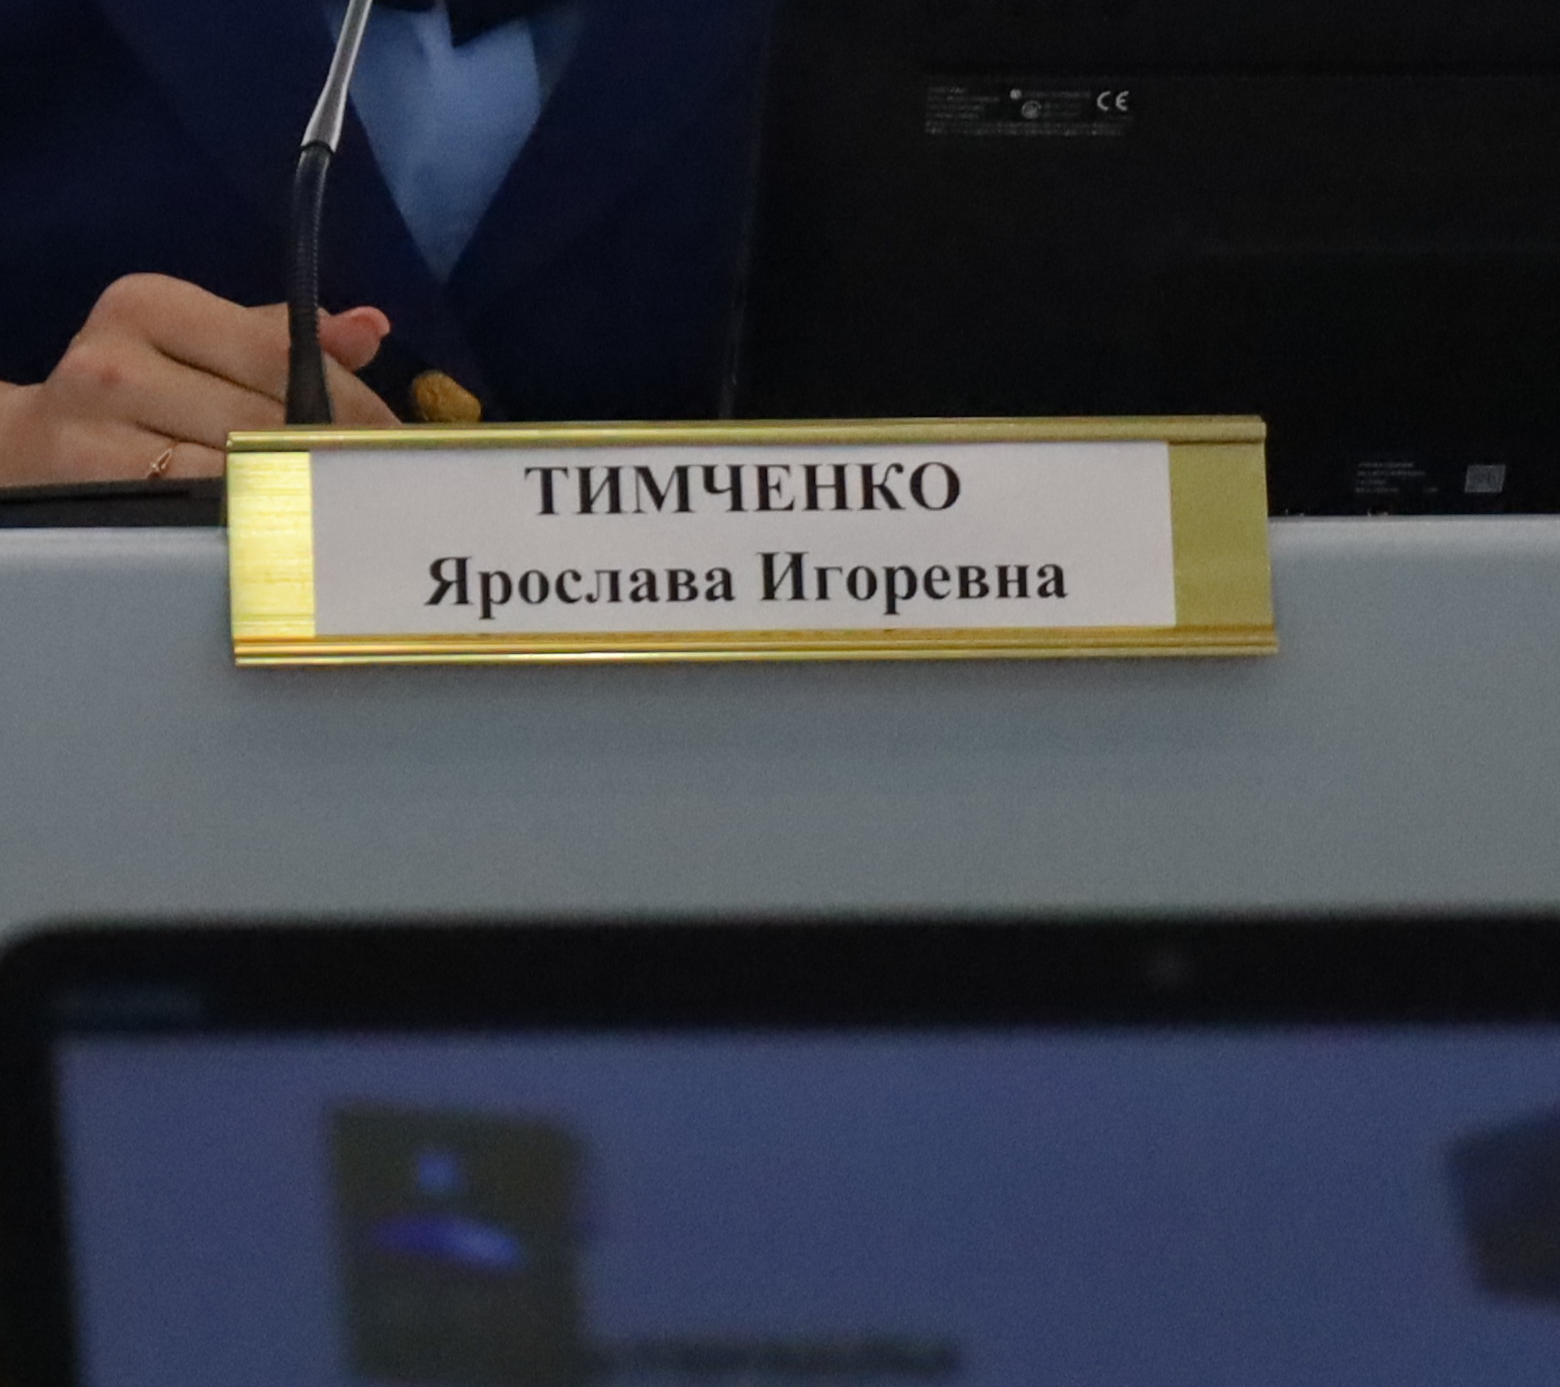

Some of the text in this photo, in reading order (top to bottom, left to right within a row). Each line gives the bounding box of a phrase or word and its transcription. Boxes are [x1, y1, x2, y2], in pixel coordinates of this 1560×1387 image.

[523, 462, 962, 516] ТИМЧЕНКО
[425, 552, 1068, 621] Ярослава Игоревна
